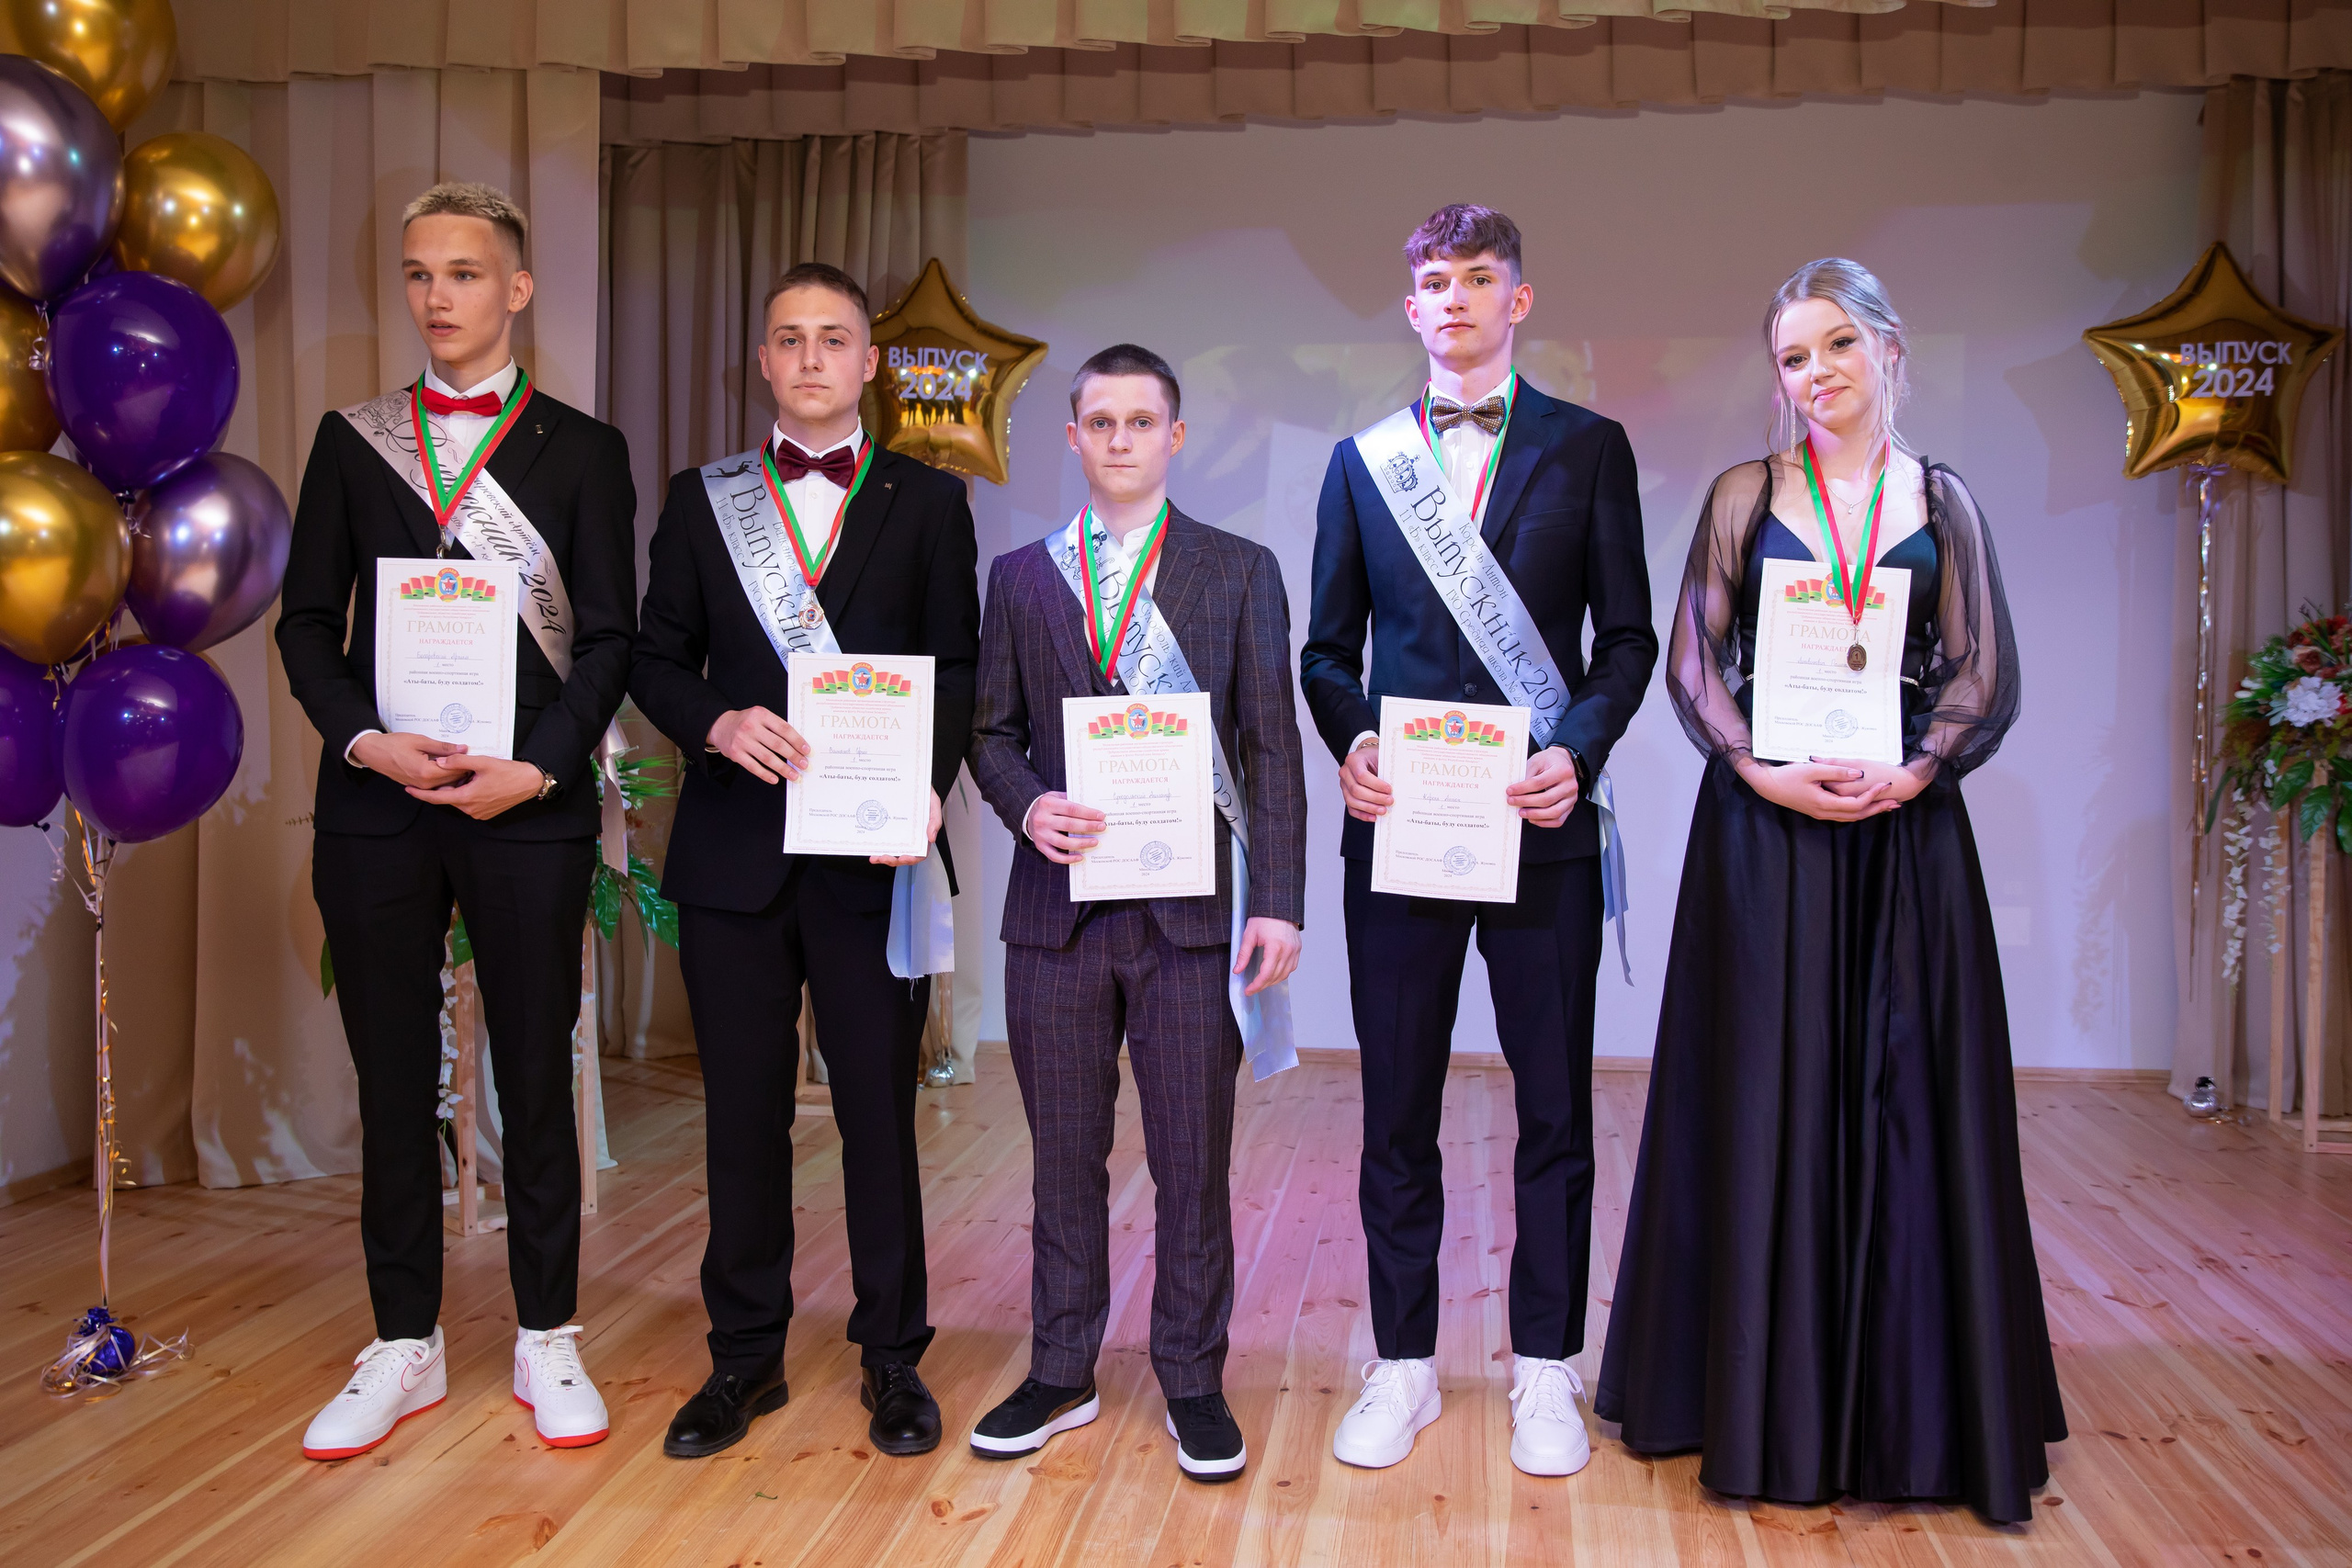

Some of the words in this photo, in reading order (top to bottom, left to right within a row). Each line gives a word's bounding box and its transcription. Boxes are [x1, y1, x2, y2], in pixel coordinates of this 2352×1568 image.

[888, 346, 989, 374] ВЫПУСК
[2180, 341, 2292, 366] ВЫПУСК
[899, 371, 972, 401] 2024
[2190, 367, 2275, 398] 2024
[716, 497, 729, 511] 11
[728, 532, 744, 560] класс
[729, 482, 815, 653] Выпускни
[1458, 522, 1485, 564] Король
[1482, 563, 1509, 600] Антон
[1398, 509, 1412, 525] 11
[1417, 544, 1439, 572] класс
[1446, 589, 1463, 612] ГУО
[1456, 610, 1488, 656] Средняя
[1486, 655, 1508, 682] школа
[1411, 485, 1532, 681] Выпускник
[518, 571, 567, 635] 2024
[407, 620, 485, 634] ГРАМОТА
[1140, 602, 1186, 678] Суходольский
[1789, 624, 1871, 642] ГРАМОТА
[1801, 643, 1848, 652] НАГРАЖДАЕТ
[820, 715, 901, 729] ГРАМОТА
[1098, 758, 1181, 773] ГРАМОТА
[1410, 761, 1492, 779] ГРАМОТА
[1112, 776, 1169, 784] НАГРАЖДАЕТСЯ
[1422, 780, 1479, 789] НАГРАЖДАЕТСЯ
